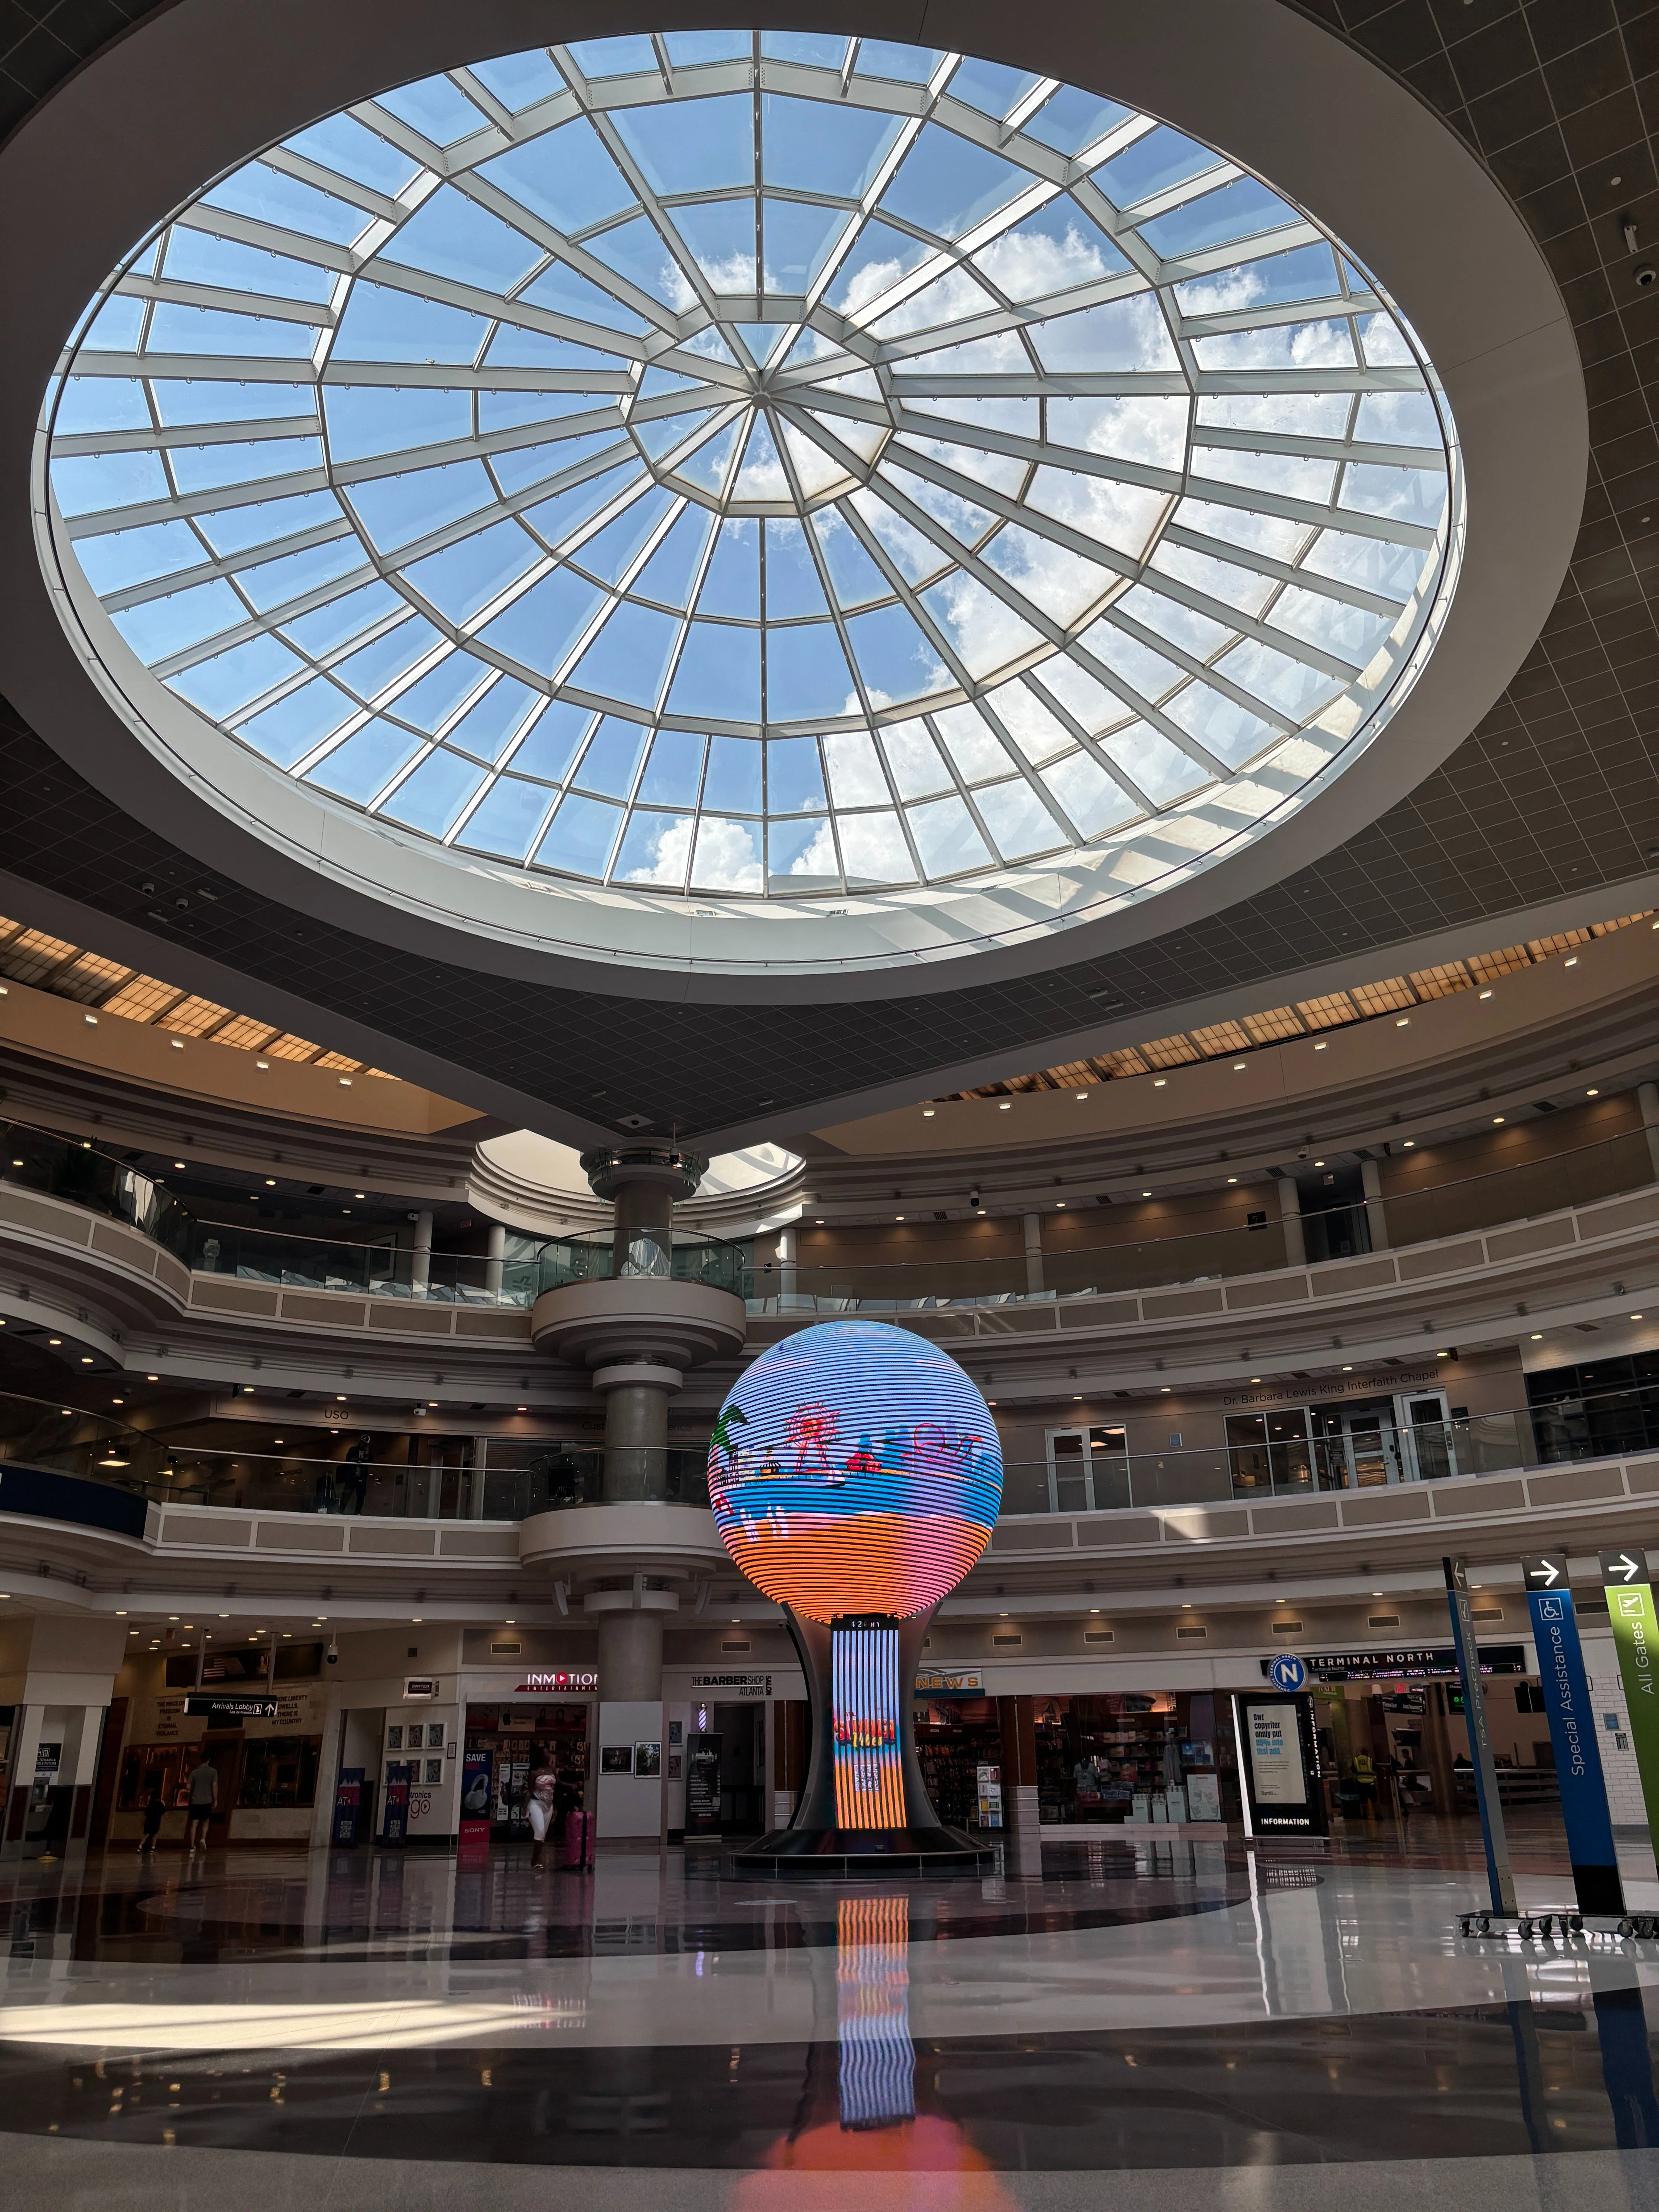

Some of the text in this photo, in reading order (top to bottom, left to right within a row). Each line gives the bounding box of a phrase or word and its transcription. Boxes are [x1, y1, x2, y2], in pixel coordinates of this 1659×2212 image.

[1224, 1369, 1439, 1405] Dr. Barbara Lewis King Interfaith Chapel
[325, 1410, 349, 1419] USO
[1310, 1652, 1434, 1667] TERMINAL NORTH
[1632, 1621, 1654, 1695] All Gates
[1281, 1663, 1298, 1683] N
[739, 1687, 764, 1696] ATLANTA
[916, 1677, 979, 1689] NEWS
[1550, 1626, 1585, 1775] Special Assistance
[1254, 1721, 1280, 1729] copyriter
[1479, 1715, 1487, 1750] TSA
[1310, 1710, 1321, 1778] INFORMATION
[466, 1753, 486, 1762] SAVE
